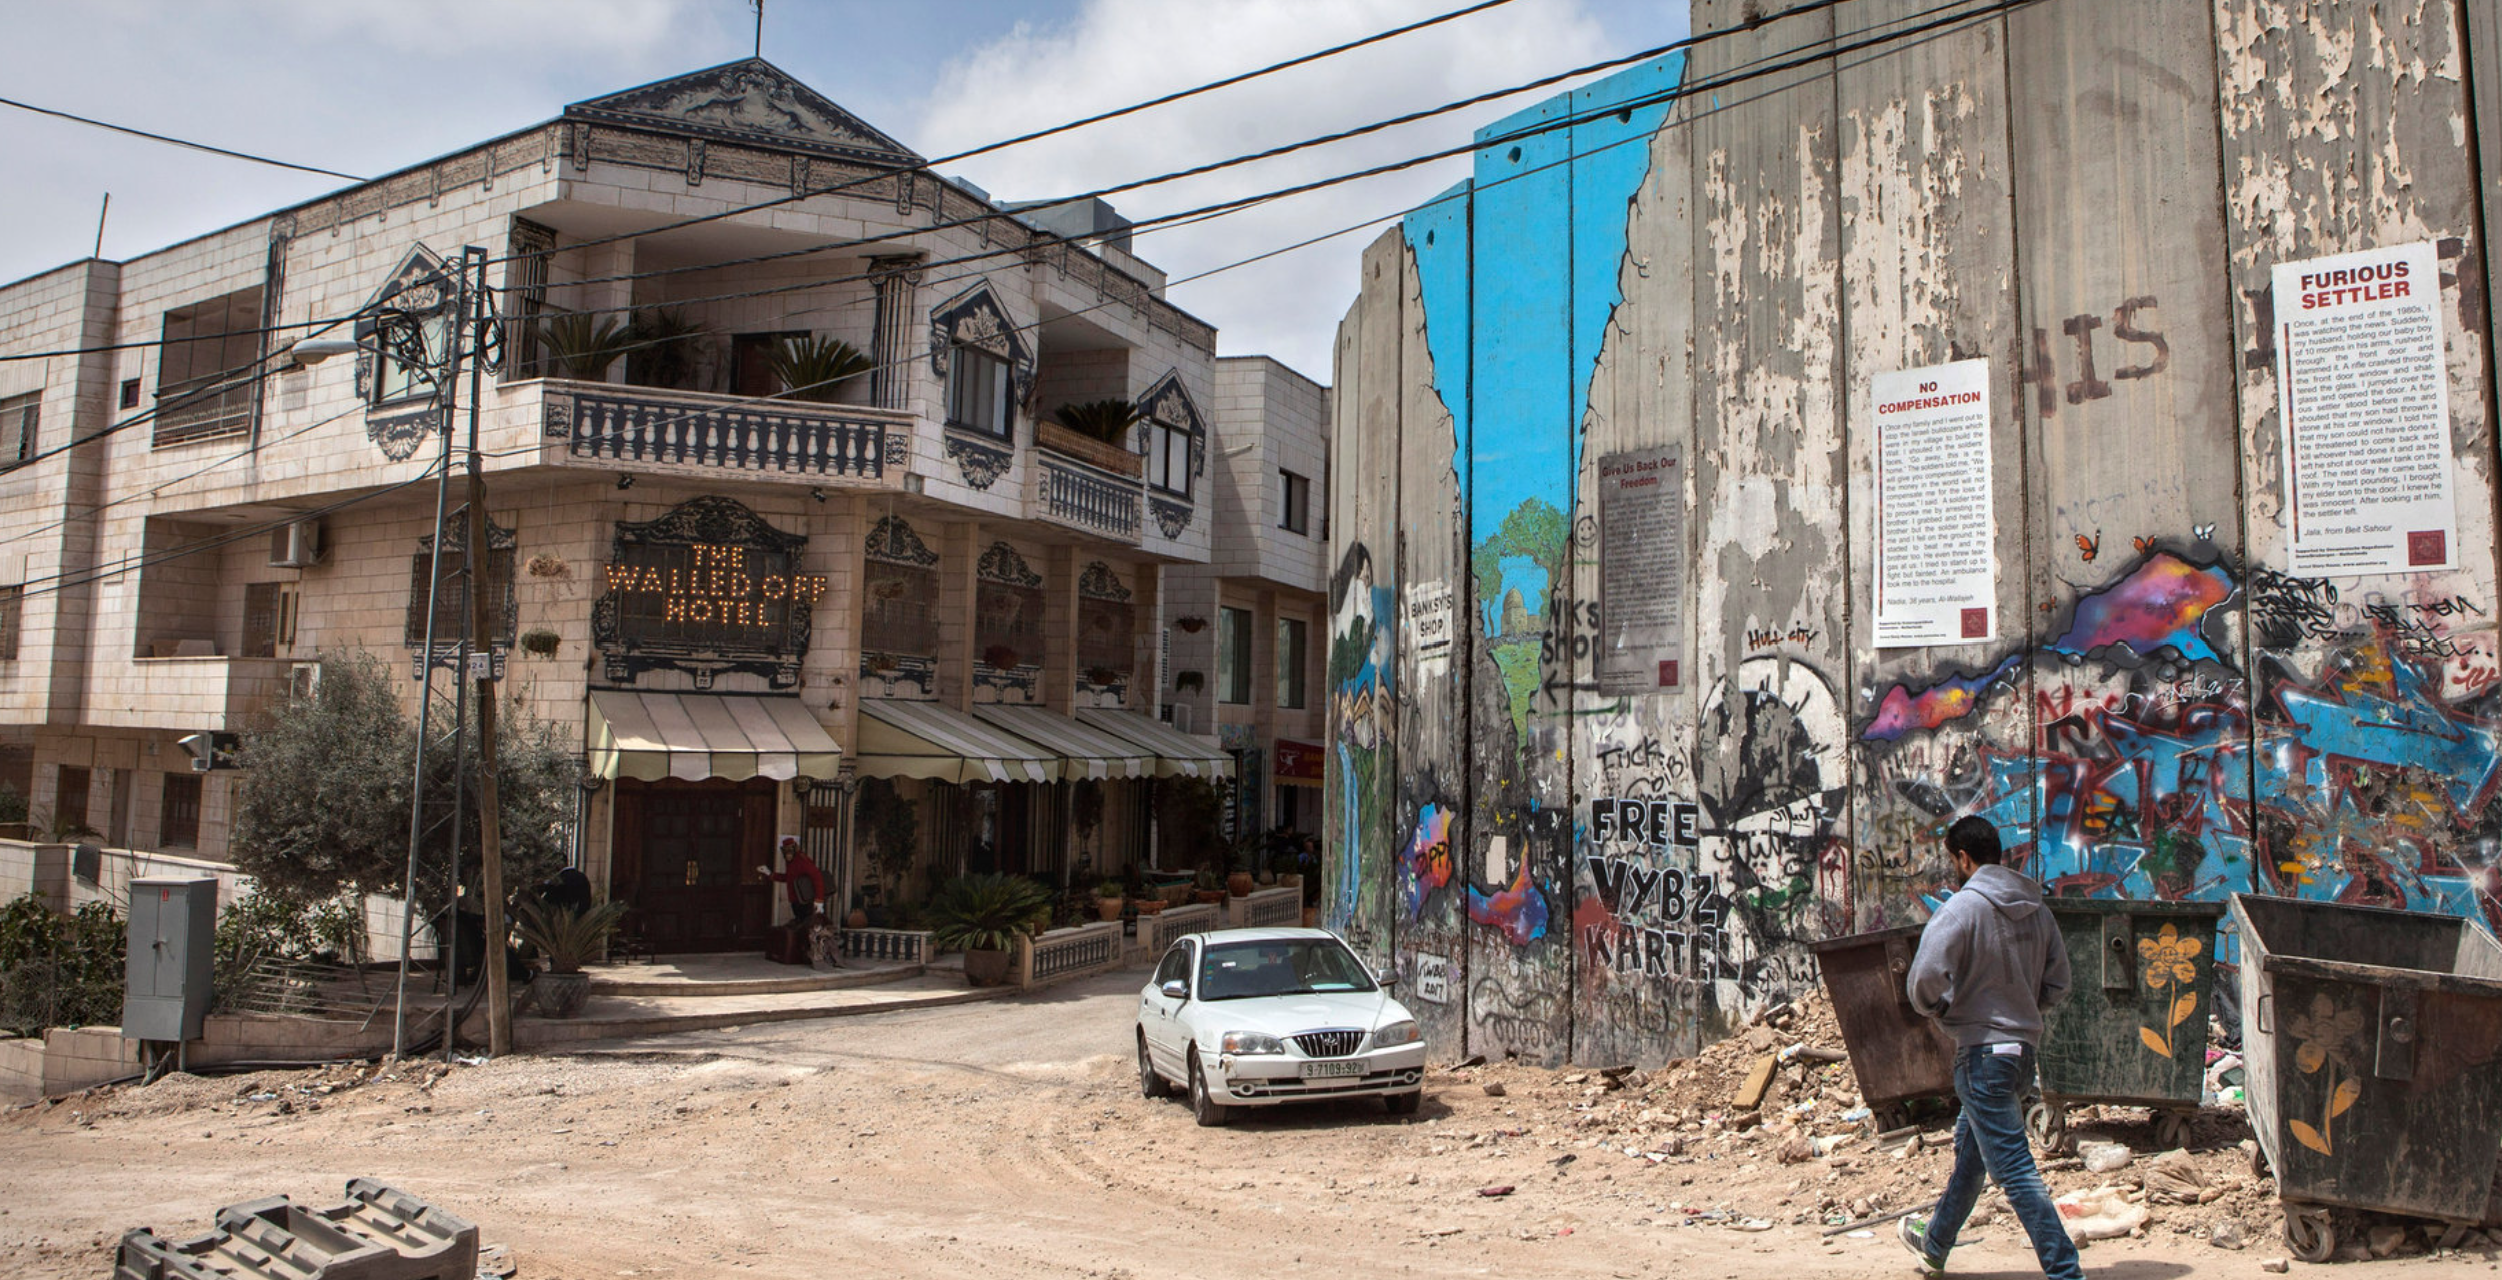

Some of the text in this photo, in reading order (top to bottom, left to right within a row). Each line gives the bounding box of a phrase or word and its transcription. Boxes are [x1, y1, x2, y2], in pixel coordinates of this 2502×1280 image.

[2301, 261, 2409, 290] FURIOUS
[2302, 281, 2410, 310] SETTLER
[2331, 314, 2345, 323] the
[2347, 311, 2364, 320] end
[2378, 308, 2392, 316] the
[2311, 323, 2347, 337] watching
[2348, 321, 2362, 330] the
[2346, 329, 2376, 342] holding
[2393, 324, 2415, 336] baby
[2416, 322, 2432, 333] boy
[2315, 343, 2345, 353] months
[2355, 340, 2368, 348] his
[2394, 333, 2423, 344] rushed
[2294, 342, 2433, 367] through the front door and
[2295, 364, 2331, 375] slammed
[2350, 359, 2366, 368] rifle
[2367, 355, 2401, 366] crashed
[2402, 351, 2434, 364] through
[2296, 376, 2309, 384] the
[2312, 373, 2331, 382] front
[2335, 371, 2354, 380] door
[2357, 366, 2389, 377] window
[2392, 364, 2409, 373] and
[2296, 384, 2317, 394] tered
[2319, 383, 2332, 391] the
[2367, 375, 2398, 388] jumped
[2421, 371, 2435, 380] the
[1919, 381, 1938, 394] NO
[2297, 394, 2318, 405] glass
[2320, 392, 2336, 400] and
[2337, 388, 2368, 401] opened
[2370, 387, 2384, 395] the
[1879, 391, 1981, 415] COMPENSATION
[2316, 401, 2340, 410] settler
[2345, 398, 2367, 407] stood
[2371, 395, 2398, 405] before
[2420, 391, 2436, 400] and
[2298, 412, 2329, 422] shouted
[2331, 410, 2347, 419] that
[2381, 405, 2398, 413] had
[2400, 401, 2429, 412] thrown
[2298, 422, 2320, 431] stone
[2332, 420, 2345, 428] his
[2403, 412, 2420, 421] told
[2421, 410, 2438, 419] him
[1602, 457, 1676, 478] Give Us Back Our
[1620, 476, 1657, 489] Freedom
[2359, 495, 2379, 504] After
[2380, 492, 2411, 504] looking
[2303, 510, 2316, 518] the
[2317, 508, 2342, 517] settler
[2324, 526, 2342, 534] from
[2344, 525, 2360, 533] Beit
[2362, 523, 2392, 532] Sahour
[692, 545, 743, 568] THE
[606, 564, 827, 602] WALLED OFF
[666, 598, 769, 627] HOTEL
[1420, 618, 1443, 637] SHOP
[1747, 628, 1784, 651] HULL
[1592, 797, 1699, 848] FREE
[1588, 856, 1718, 926] VYBZ
[1585, 922, 1743, 984] KARTEL
